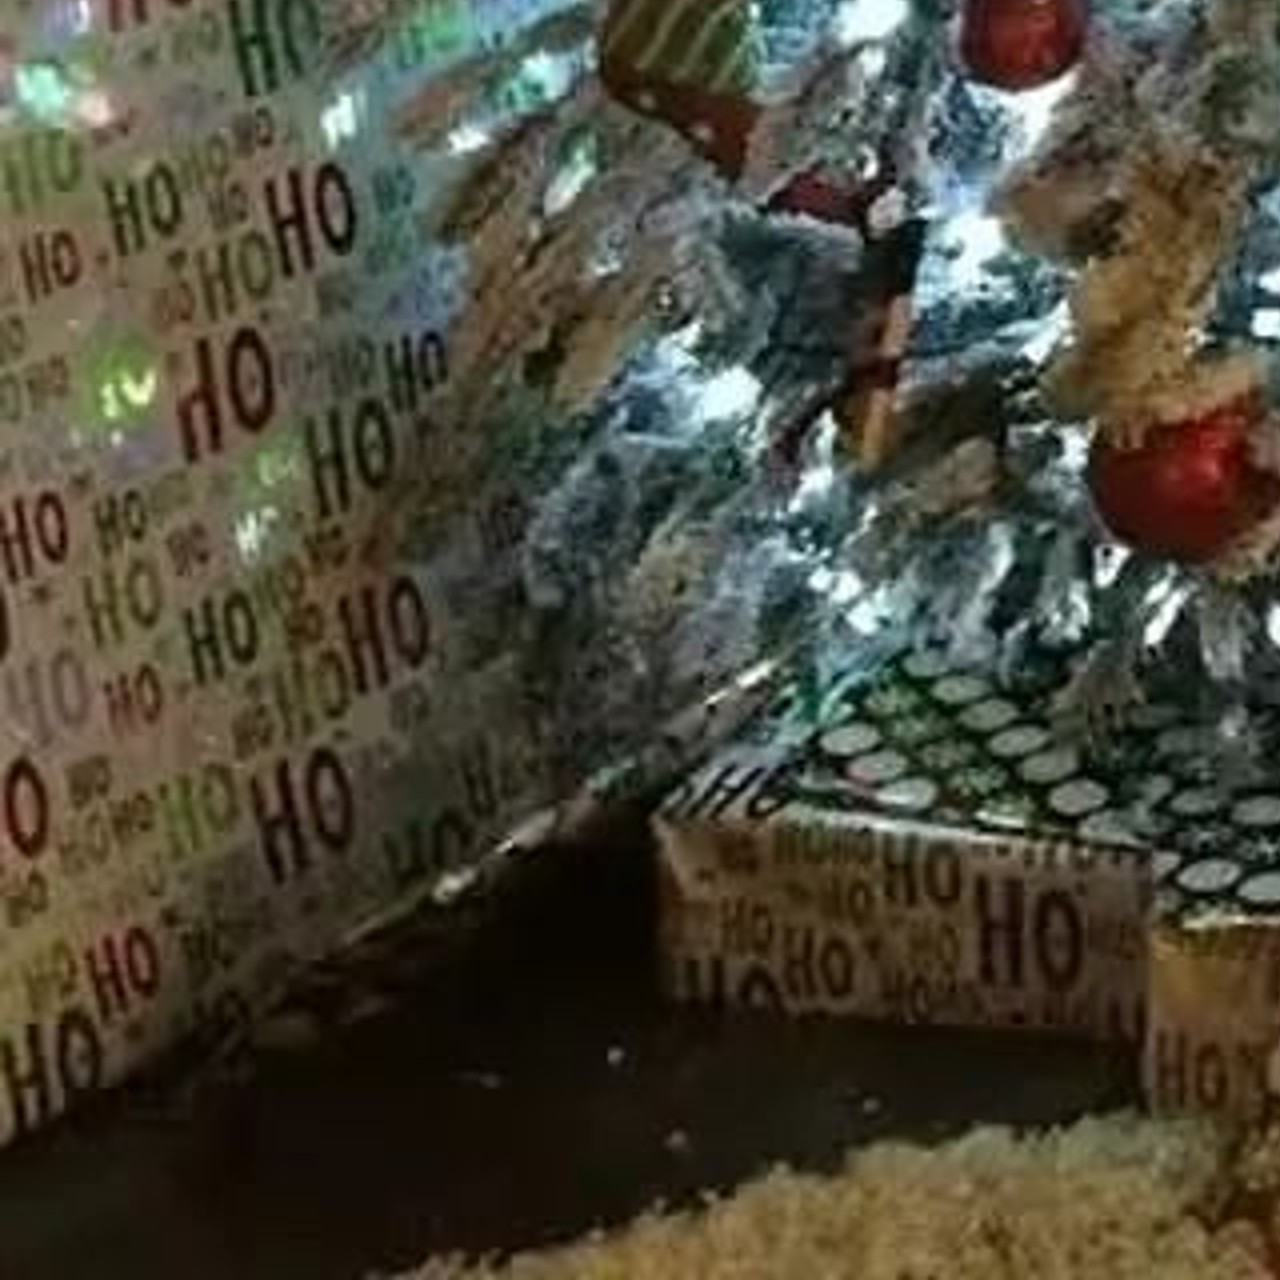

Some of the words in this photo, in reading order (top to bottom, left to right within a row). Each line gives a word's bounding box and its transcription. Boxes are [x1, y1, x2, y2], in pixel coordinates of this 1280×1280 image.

[104, 162, 181, 257] HO
[264, 162, 357, 278] HO
[196, 230, 274, 321] HO
[303, 397, 394, 517] HO
[83, 560, 162, 648] HO
[184, 590, 258, 686] HO
[335, 575, 429, 695] HO
[104, 663, 163, 742] HO
[250, 746, 353, 886] HO
[84, 926, 161, 1021] HO
[976, 874, 1084, 993] HO
